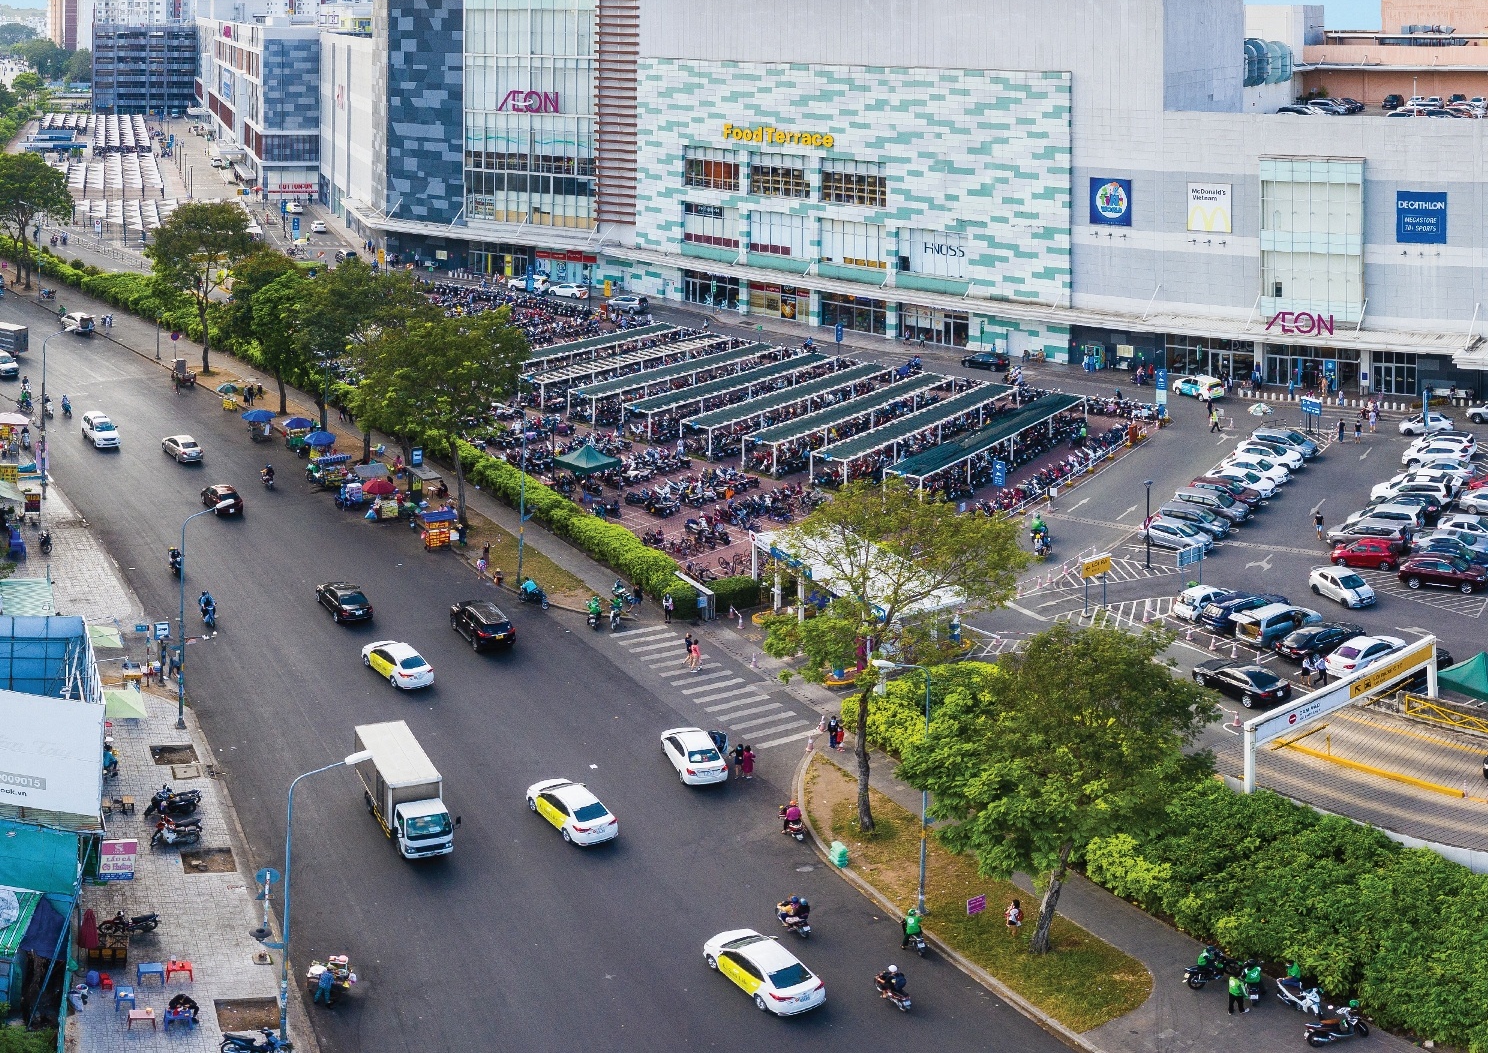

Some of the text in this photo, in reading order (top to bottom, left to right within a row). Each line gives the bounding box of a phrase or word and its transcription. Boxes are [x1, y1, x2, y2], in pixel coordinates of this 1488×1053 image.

[723, 123, 834, 148] Food Terrace
[1191, 188, 1226, 196] McDonald's
[1398, 200, 1444, 210] DECATHLON
[924, 241, 965, 258] HNOSS
[0, 772, 41, 788] 009015
